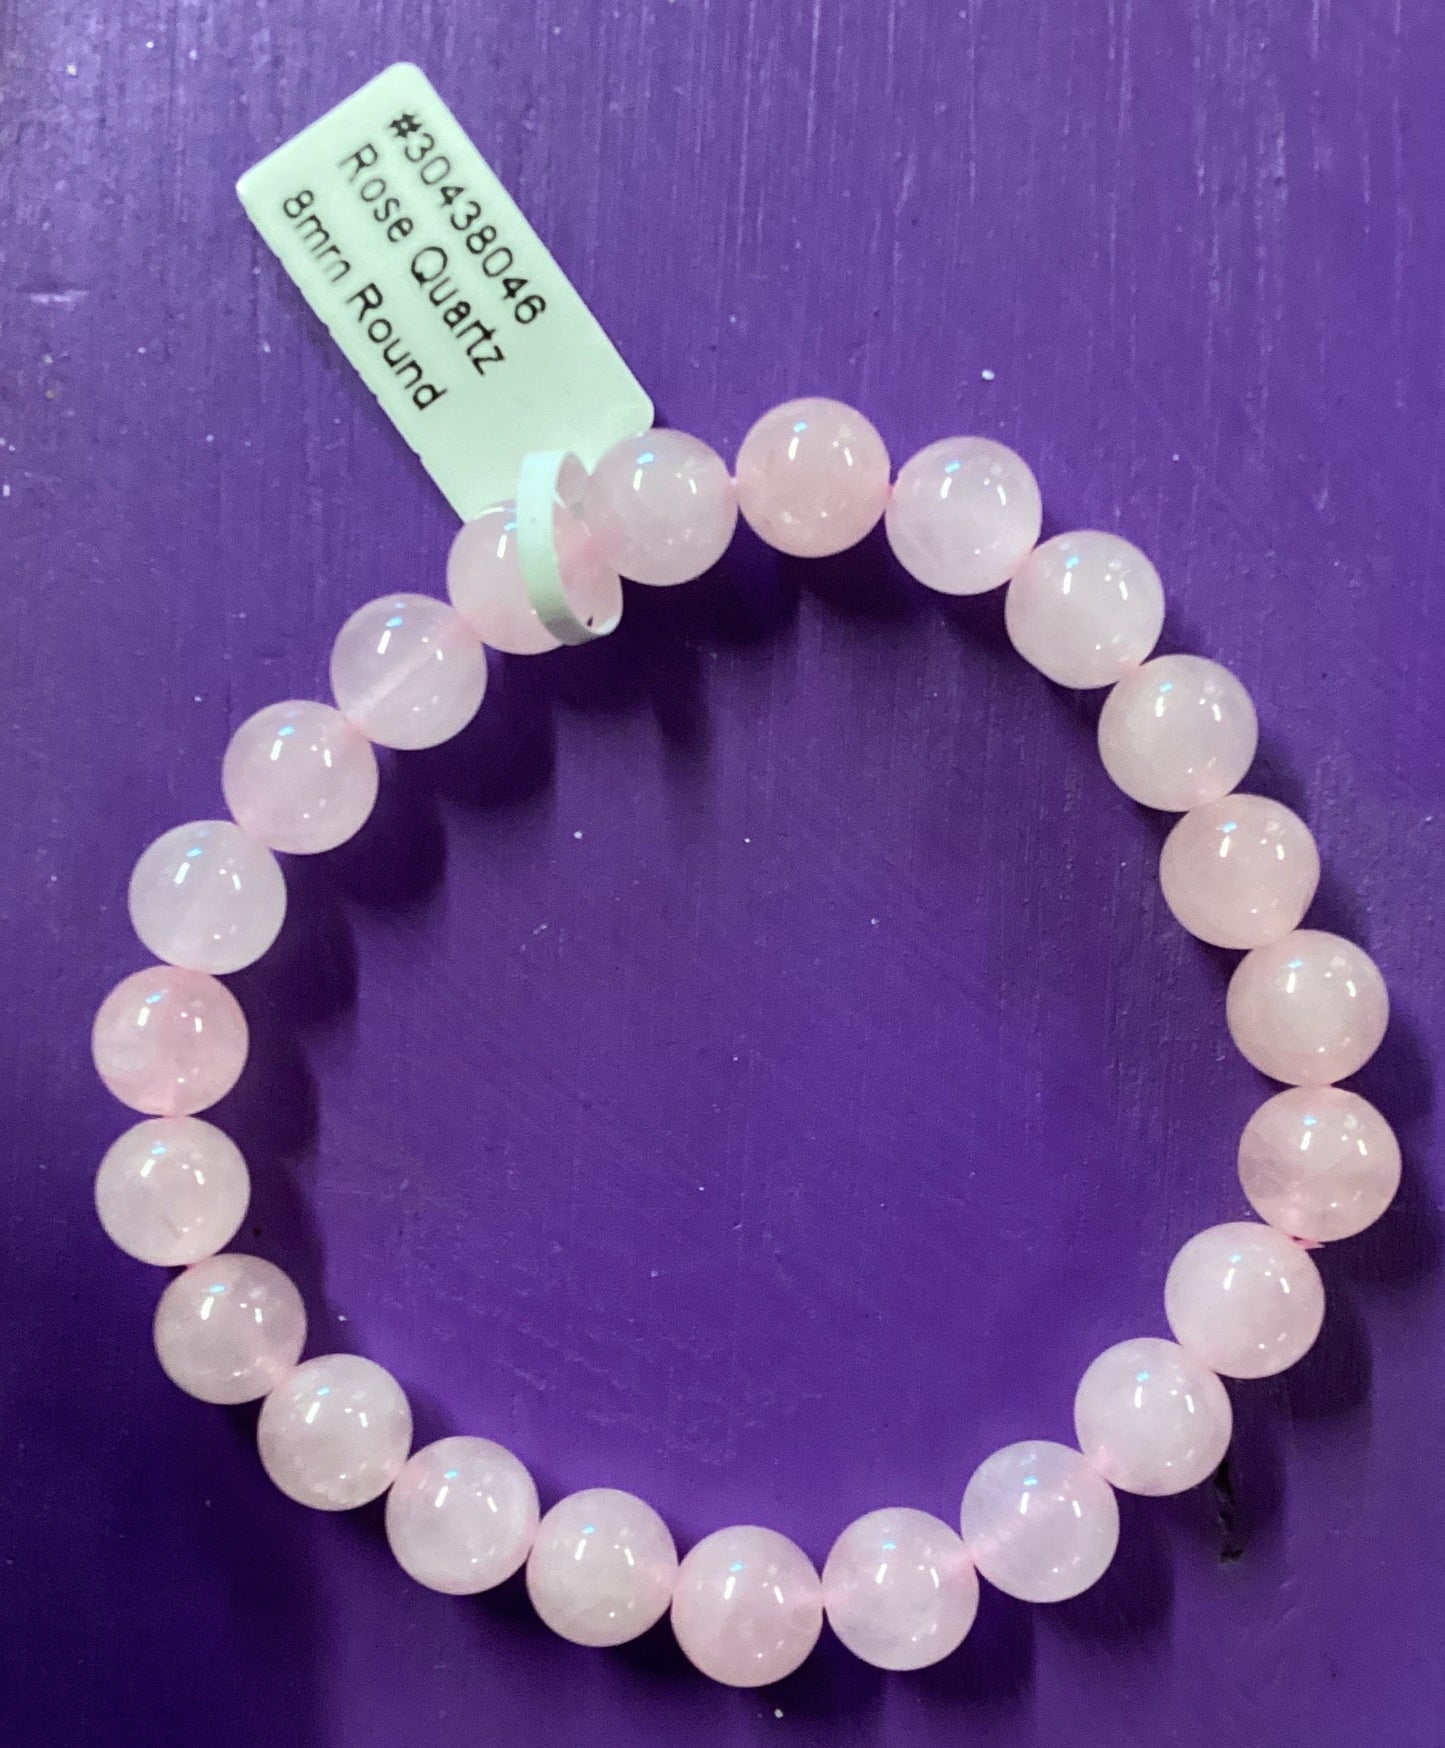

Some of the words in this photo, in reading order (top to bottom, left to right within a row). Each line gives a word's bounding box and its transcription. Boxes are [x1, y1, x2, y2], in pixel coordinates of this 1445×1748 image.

[282, 188, 353, 283] 8mm
[346, 281, 448, 411] Round
[337, 143, 414, 243] Rose
[410, 245, 506, 377] Quartz
[389, 112, 547, 326] #30438046
